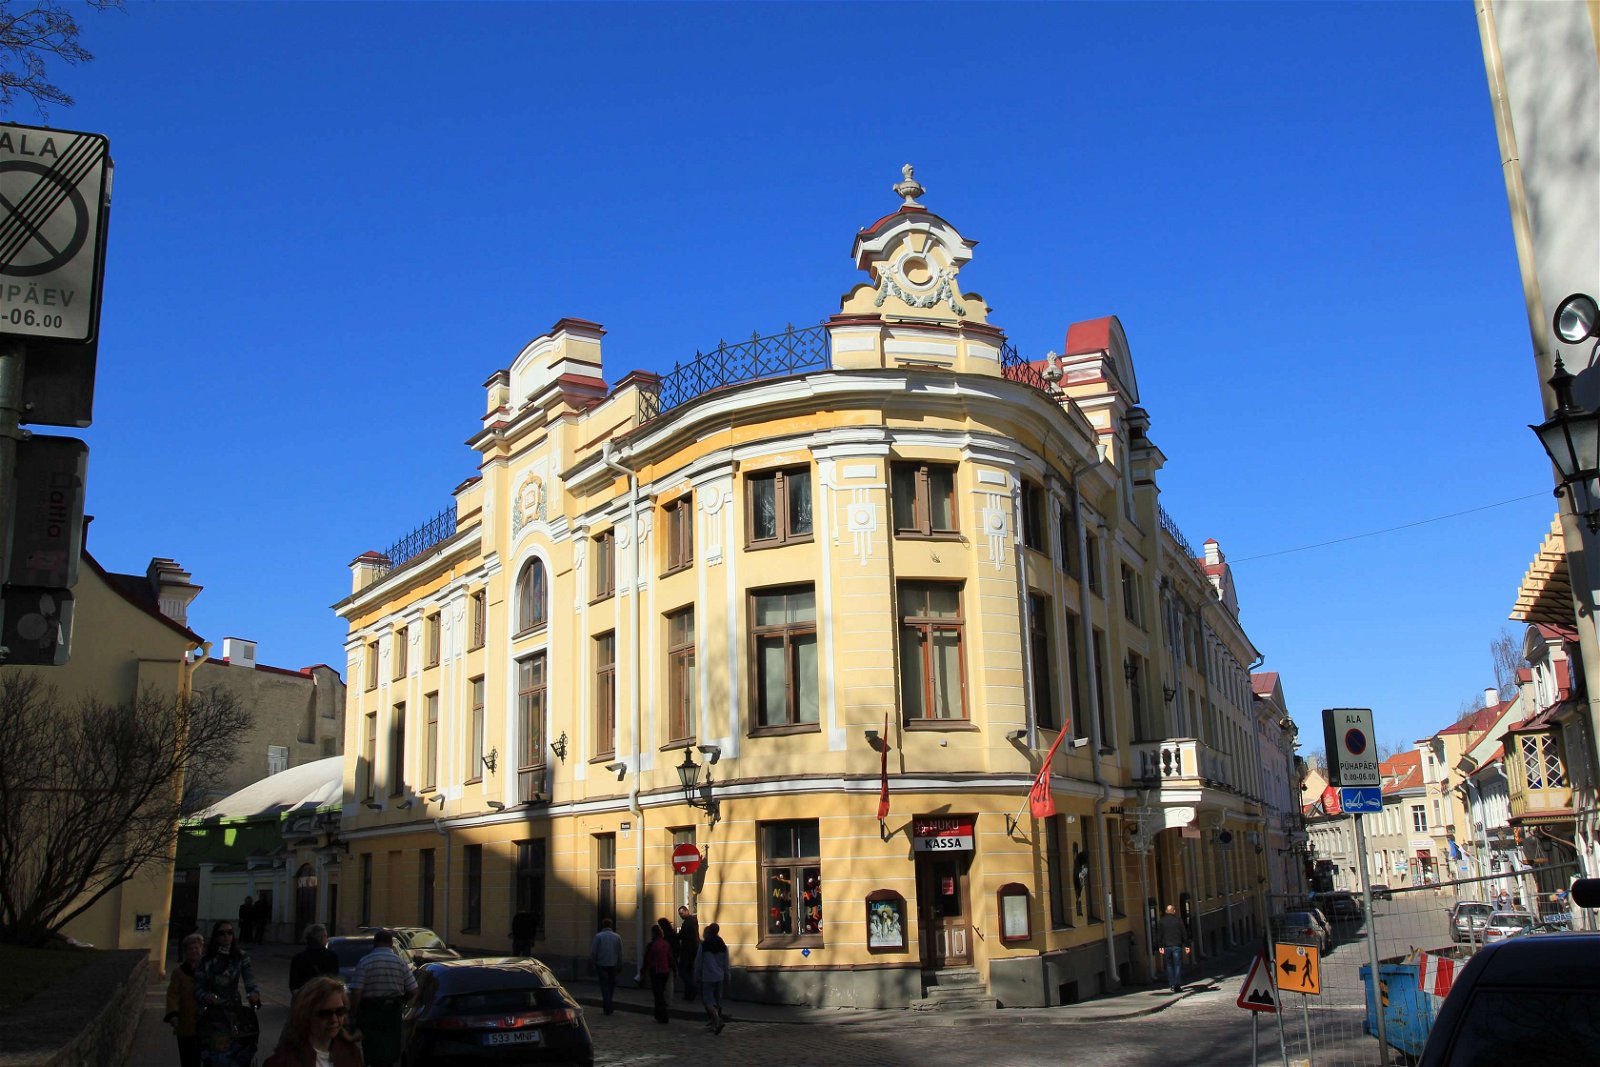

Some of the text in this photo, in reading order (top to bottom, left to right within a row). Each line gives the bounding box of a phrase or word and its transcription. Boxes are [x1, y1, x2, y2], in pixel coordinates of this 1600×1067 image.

[0, 282, 75, 307] PÄEV
[1346, 715, 1362, 723] ALA
[1340, 760, 1377, 770] PÜHAPÄEV
[930, 819, 960, 831] NUKU
[925, 838, 962, 849] KASSA
[491, 1033, 510, 1043] 533
